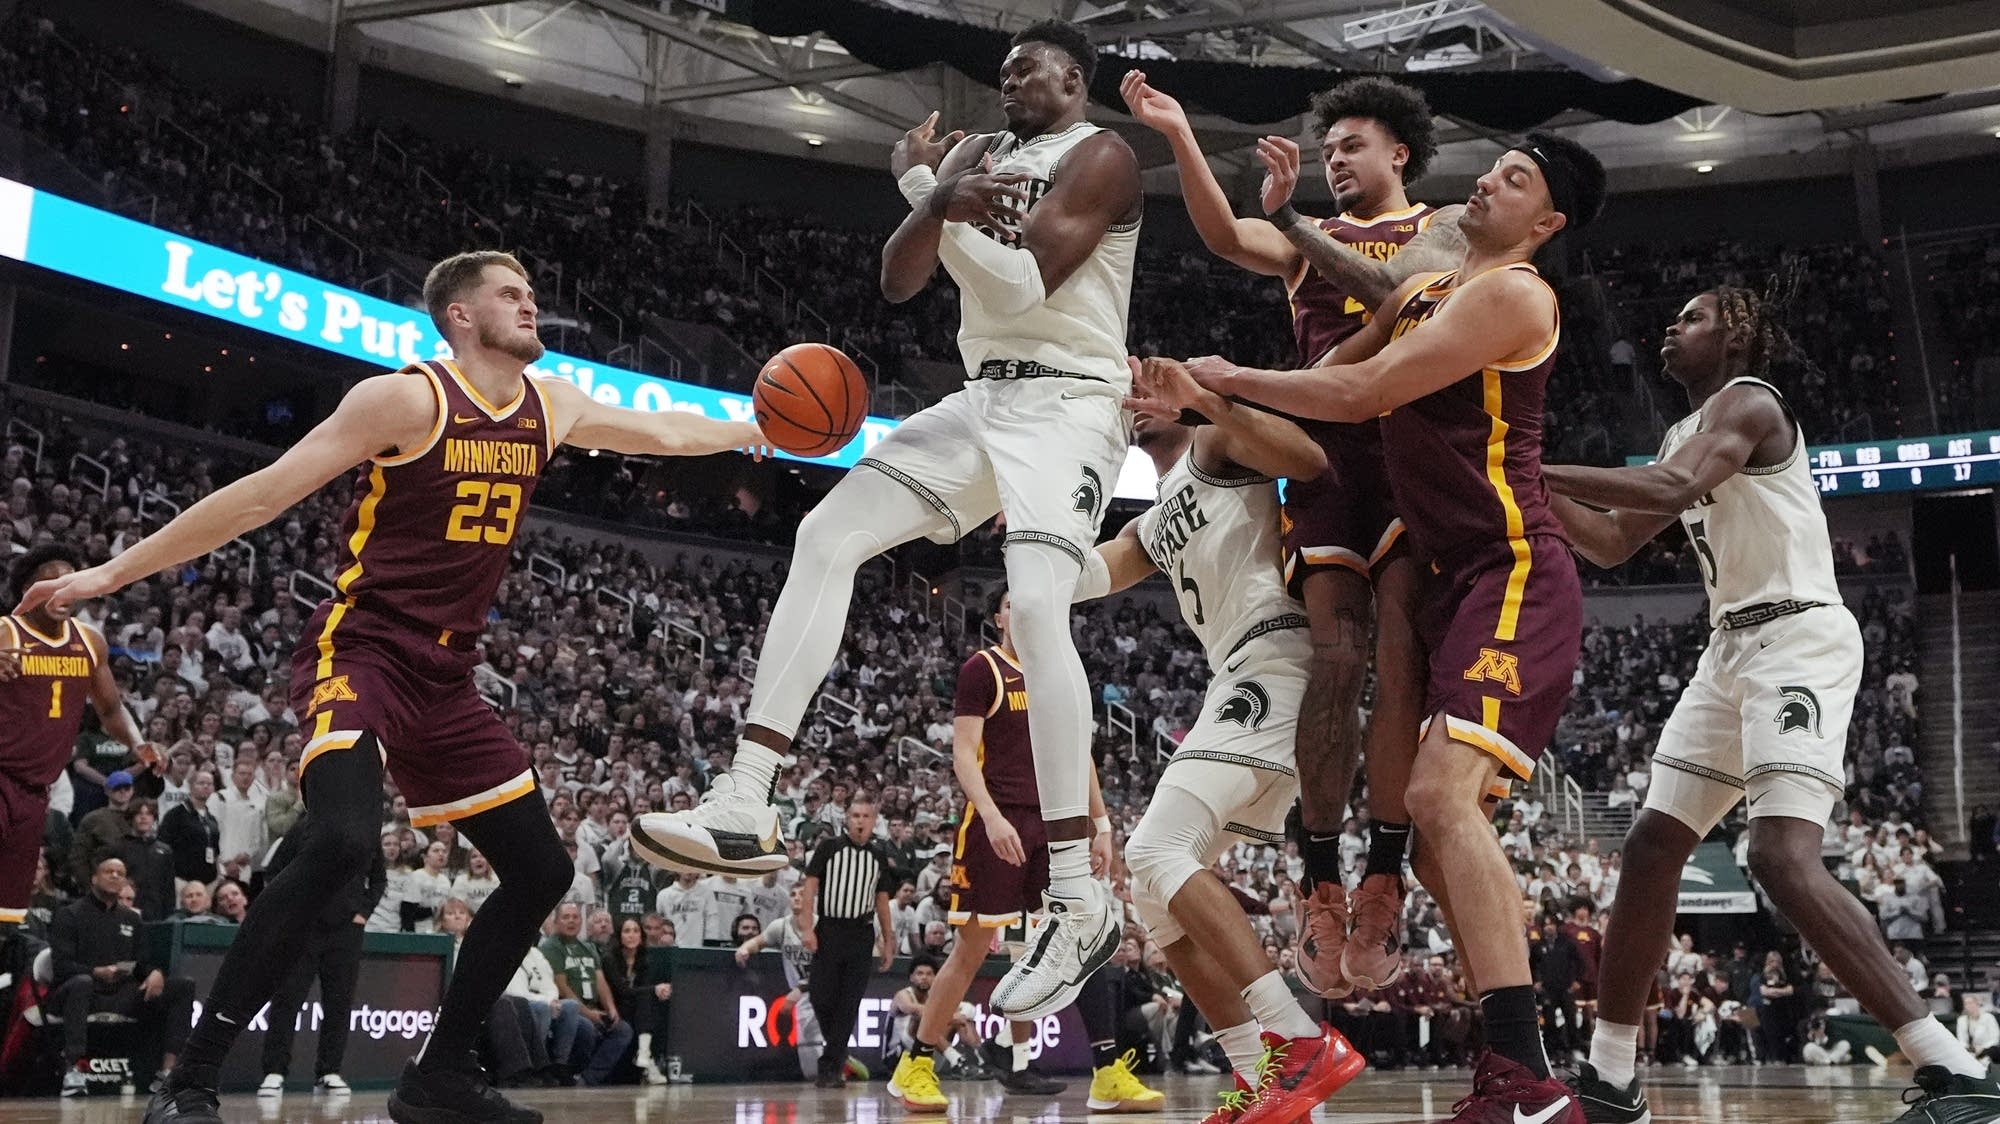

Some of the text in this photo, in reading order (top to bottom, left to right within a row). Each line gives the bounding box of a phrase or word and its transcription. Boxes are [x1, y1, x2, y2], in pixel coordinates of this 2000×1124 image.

[161, 240, 308, 332] Let's
[319, 290, 423, 364] Put
[443, 438, 537, 477] MINNESOTA
[1947, 438, 1972, 457] AST
[1953, 463, 1972, 481] 17
[445, 480, 522, 545] 23
[21, 655, 90, 677] MINNESOTA
[48, 680, 64, 718] 1
[627, 888, 640, 903] 2
[75, 1056, 130, 1073] OCKET
